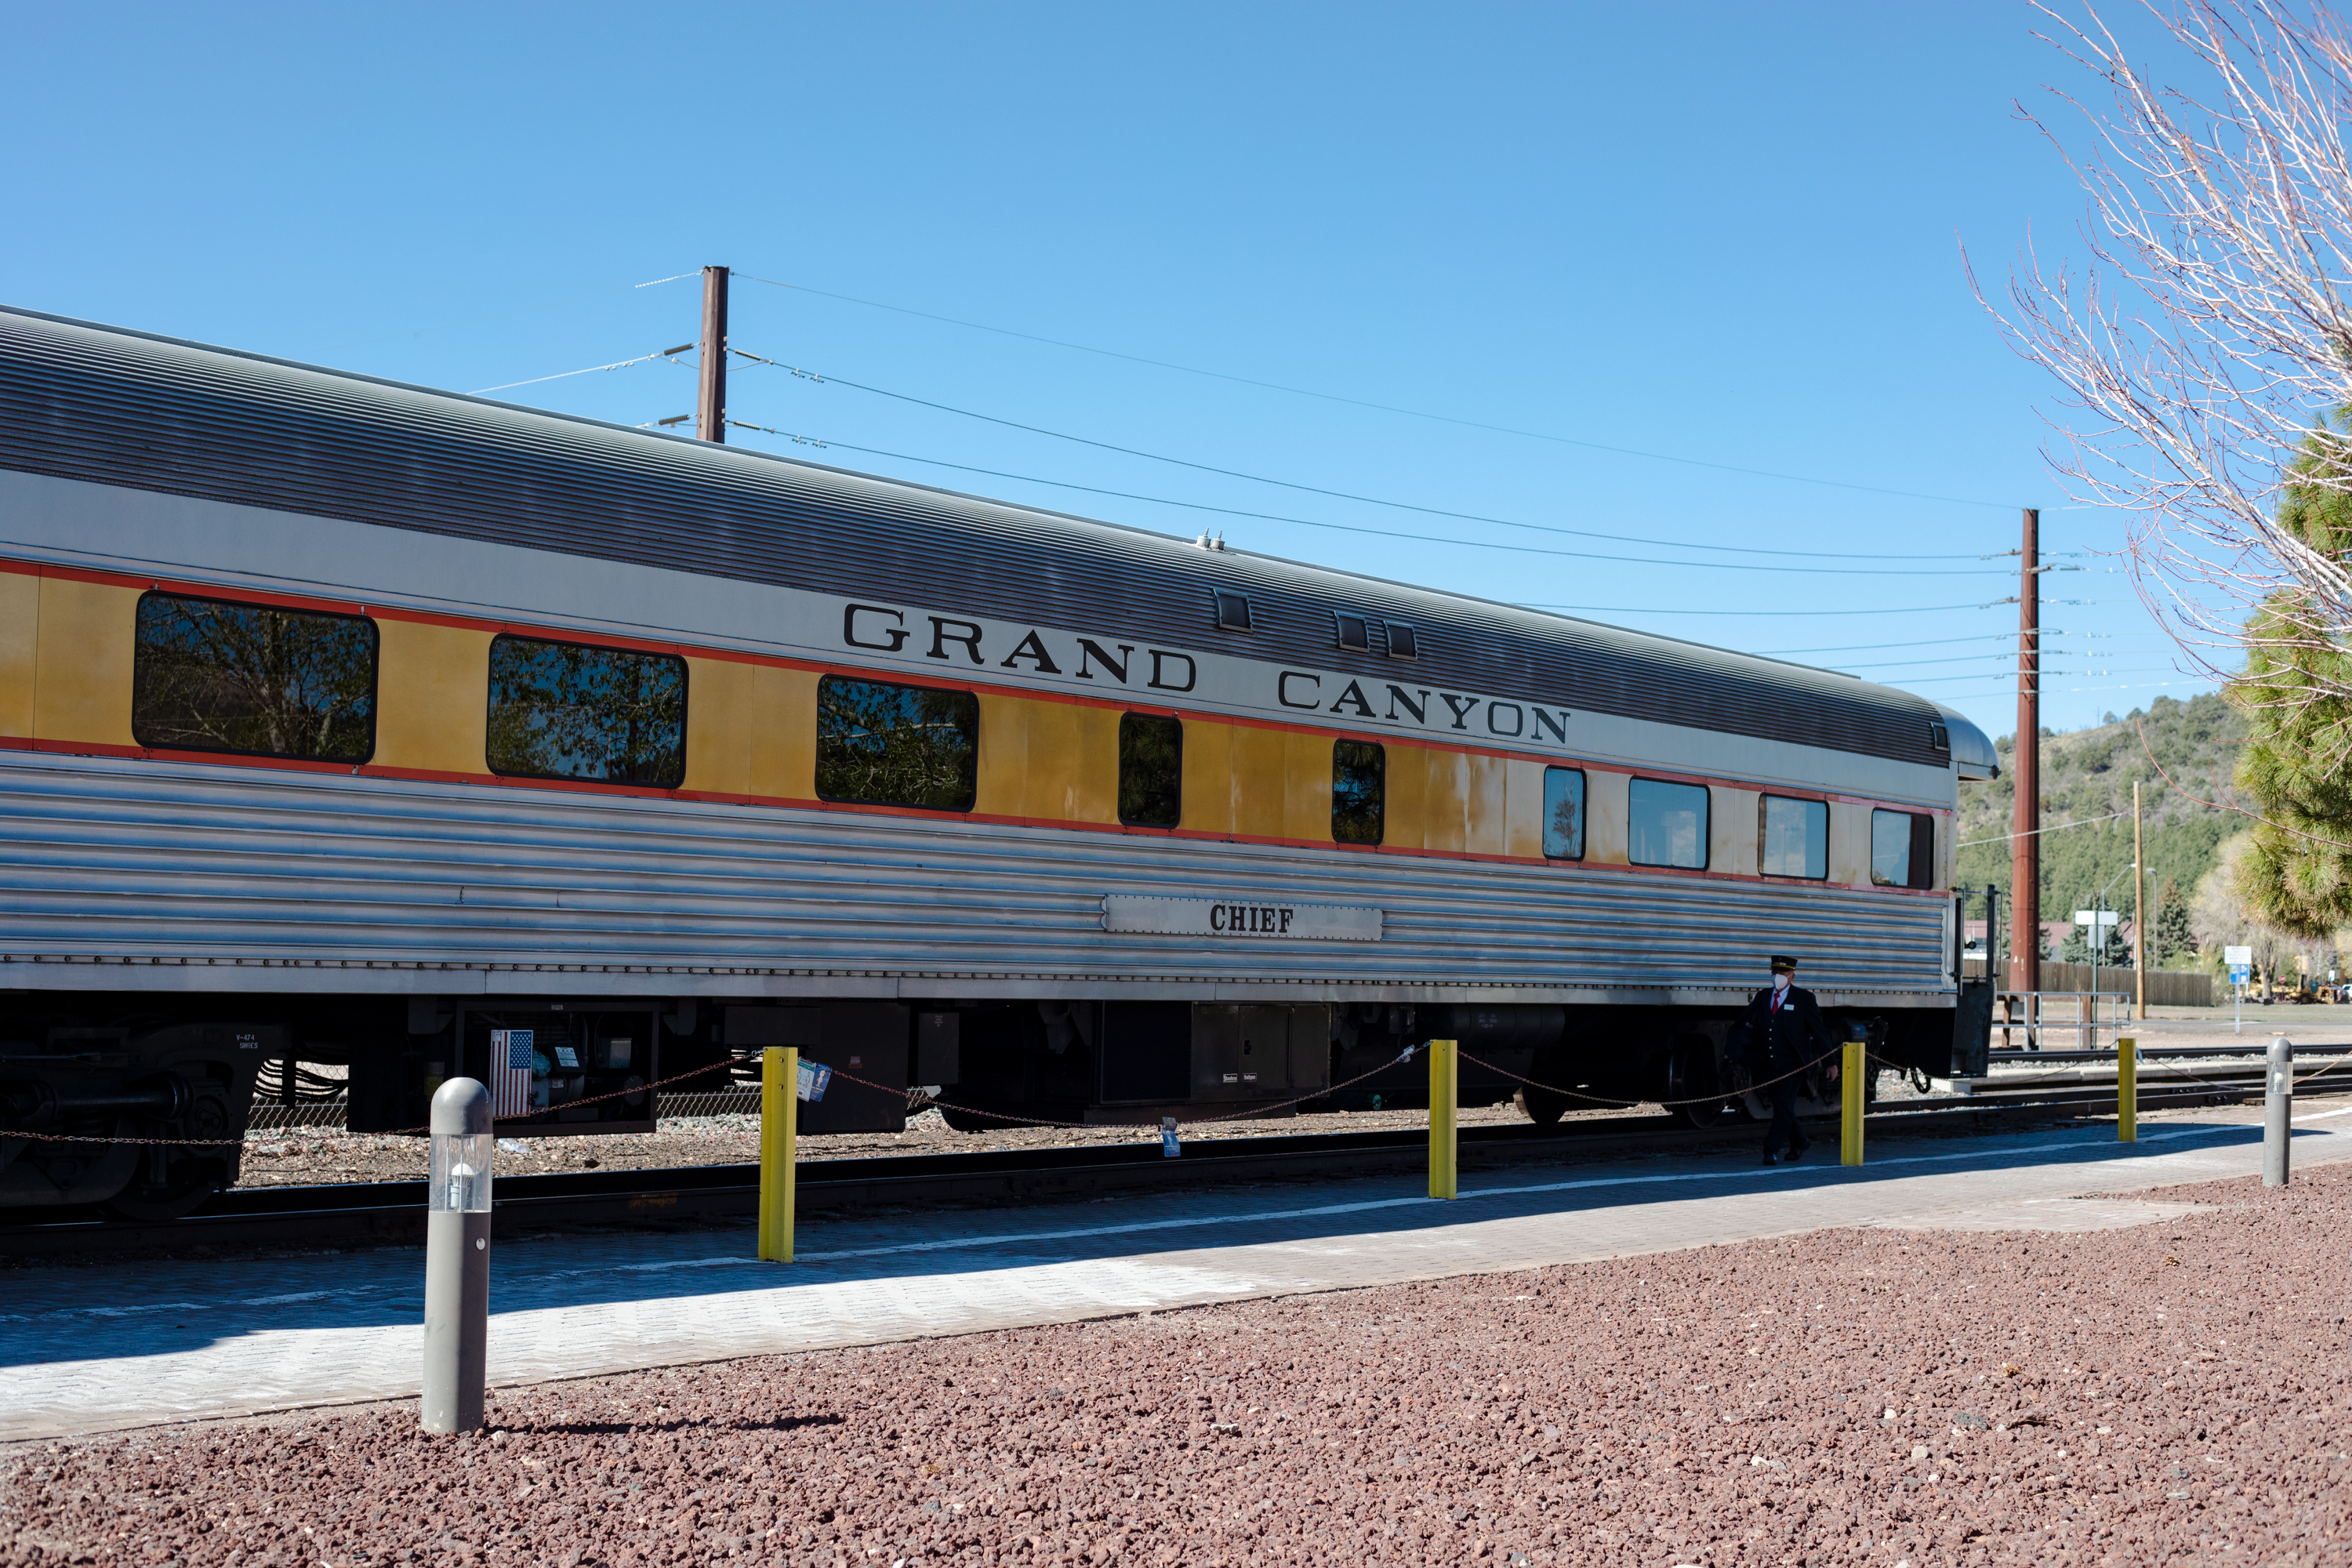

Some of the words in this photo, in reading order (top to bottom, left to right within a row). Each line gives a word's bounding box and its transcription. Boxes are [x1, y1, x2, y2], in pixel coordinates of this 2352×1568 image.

[844, 603, 1196, 692] GRAND
[1278, 670, 1570, 744] CANYON
[1210, 904, 1293, 933] CHIEF
